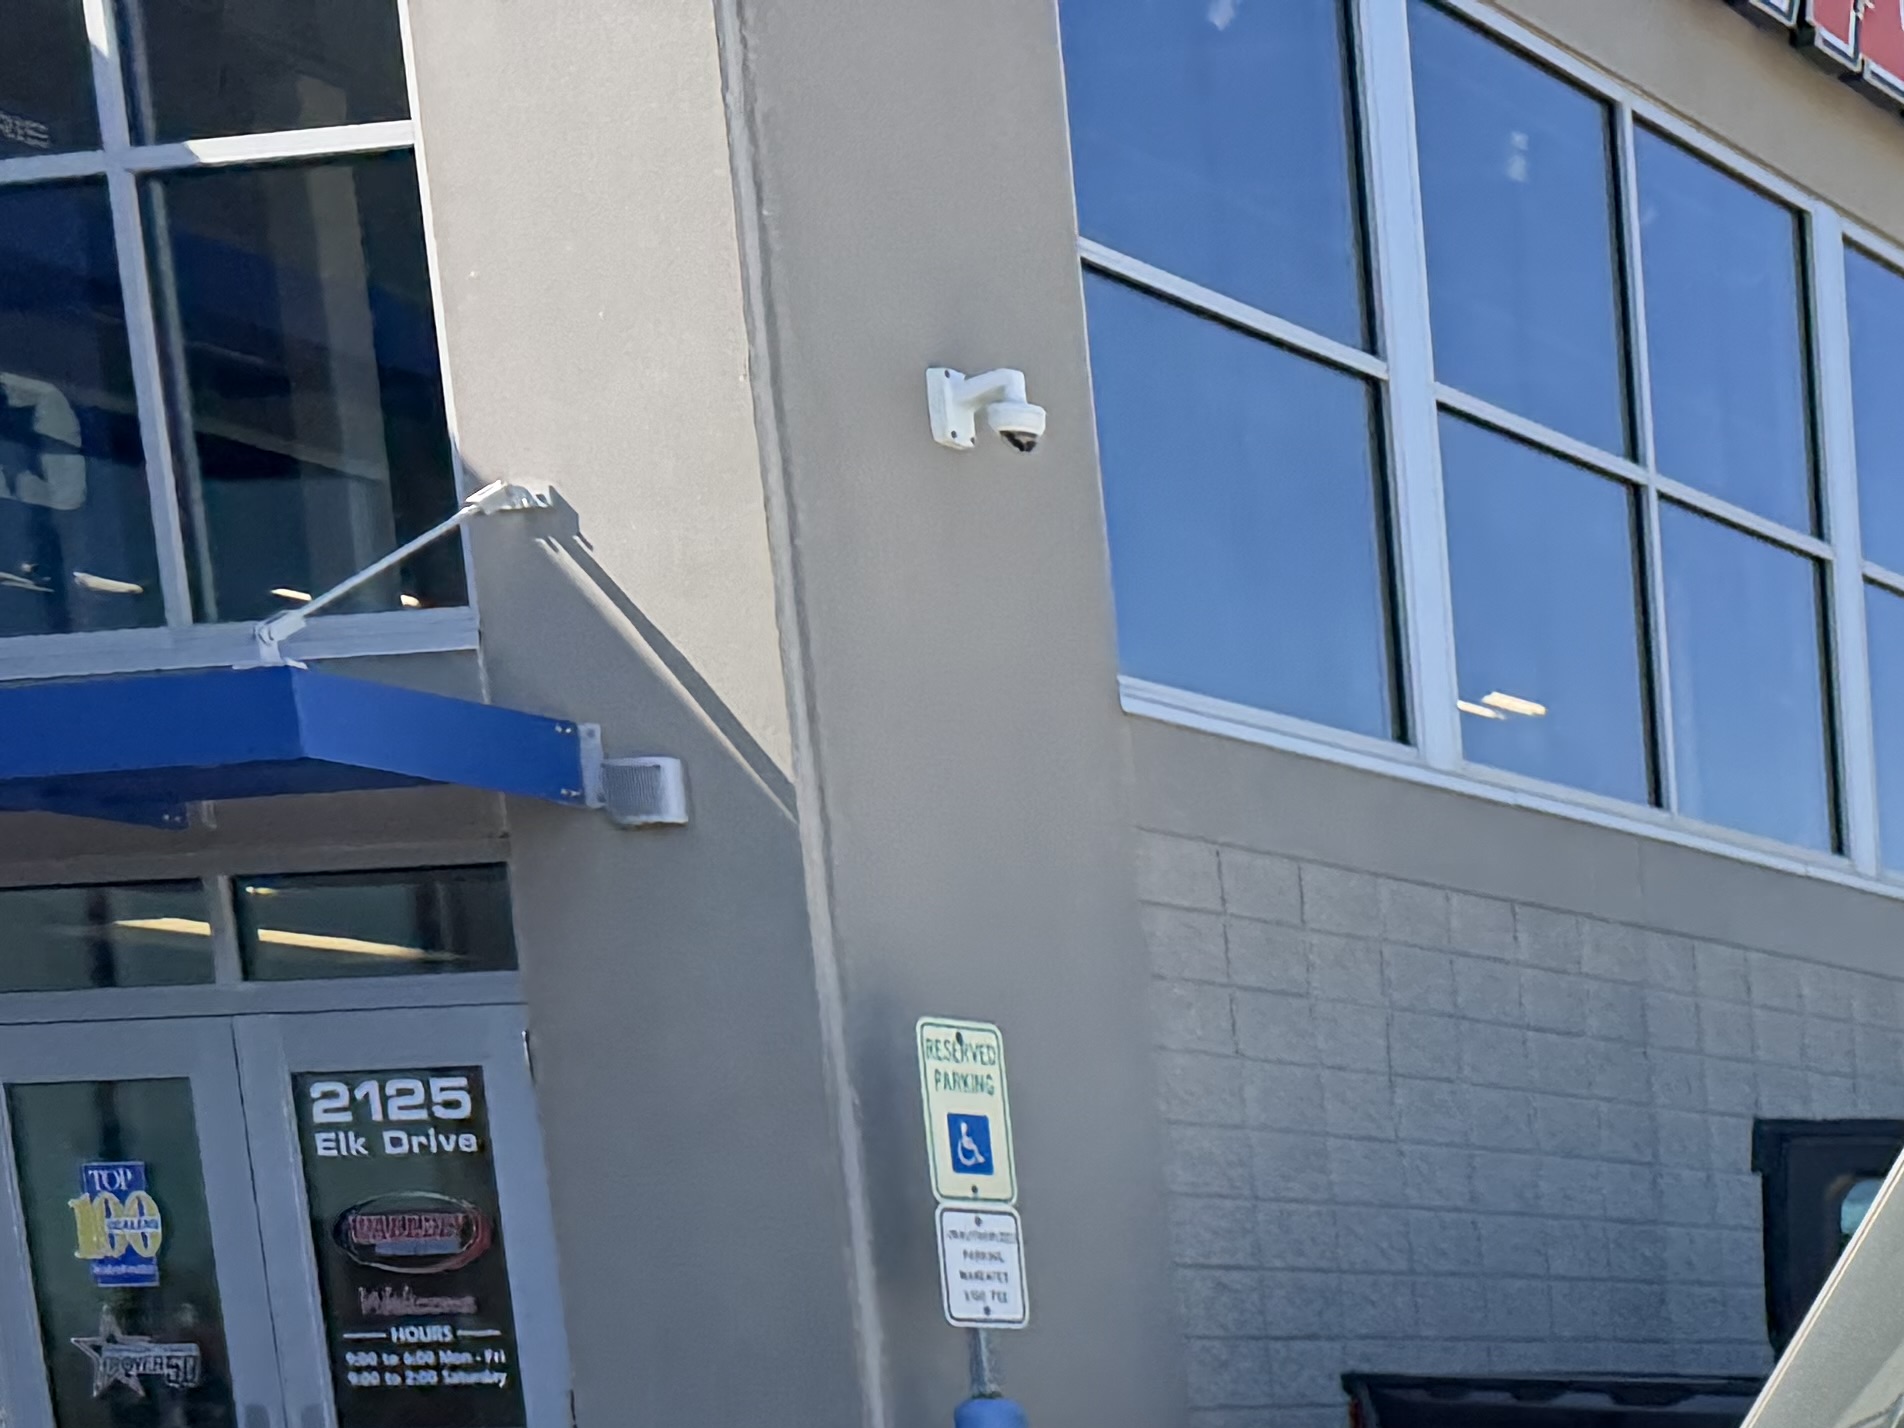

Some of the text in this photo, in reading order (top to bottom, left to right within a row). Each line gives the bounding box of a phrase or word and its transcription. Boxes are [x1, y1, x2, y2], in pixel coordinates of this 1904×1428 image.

[925, 1038, 996, 1066] RESERVED
[934, 1068, 995, 1096] PARKING
[309, 1076, 472, 1123] 2125
[314, 1127, 478, 1156] Elk Drive
[88, 1167, 132, 1191] TOP
[68, 1190, 162, 1259] 100
[390, 1325, 454, 1343] HOURS
